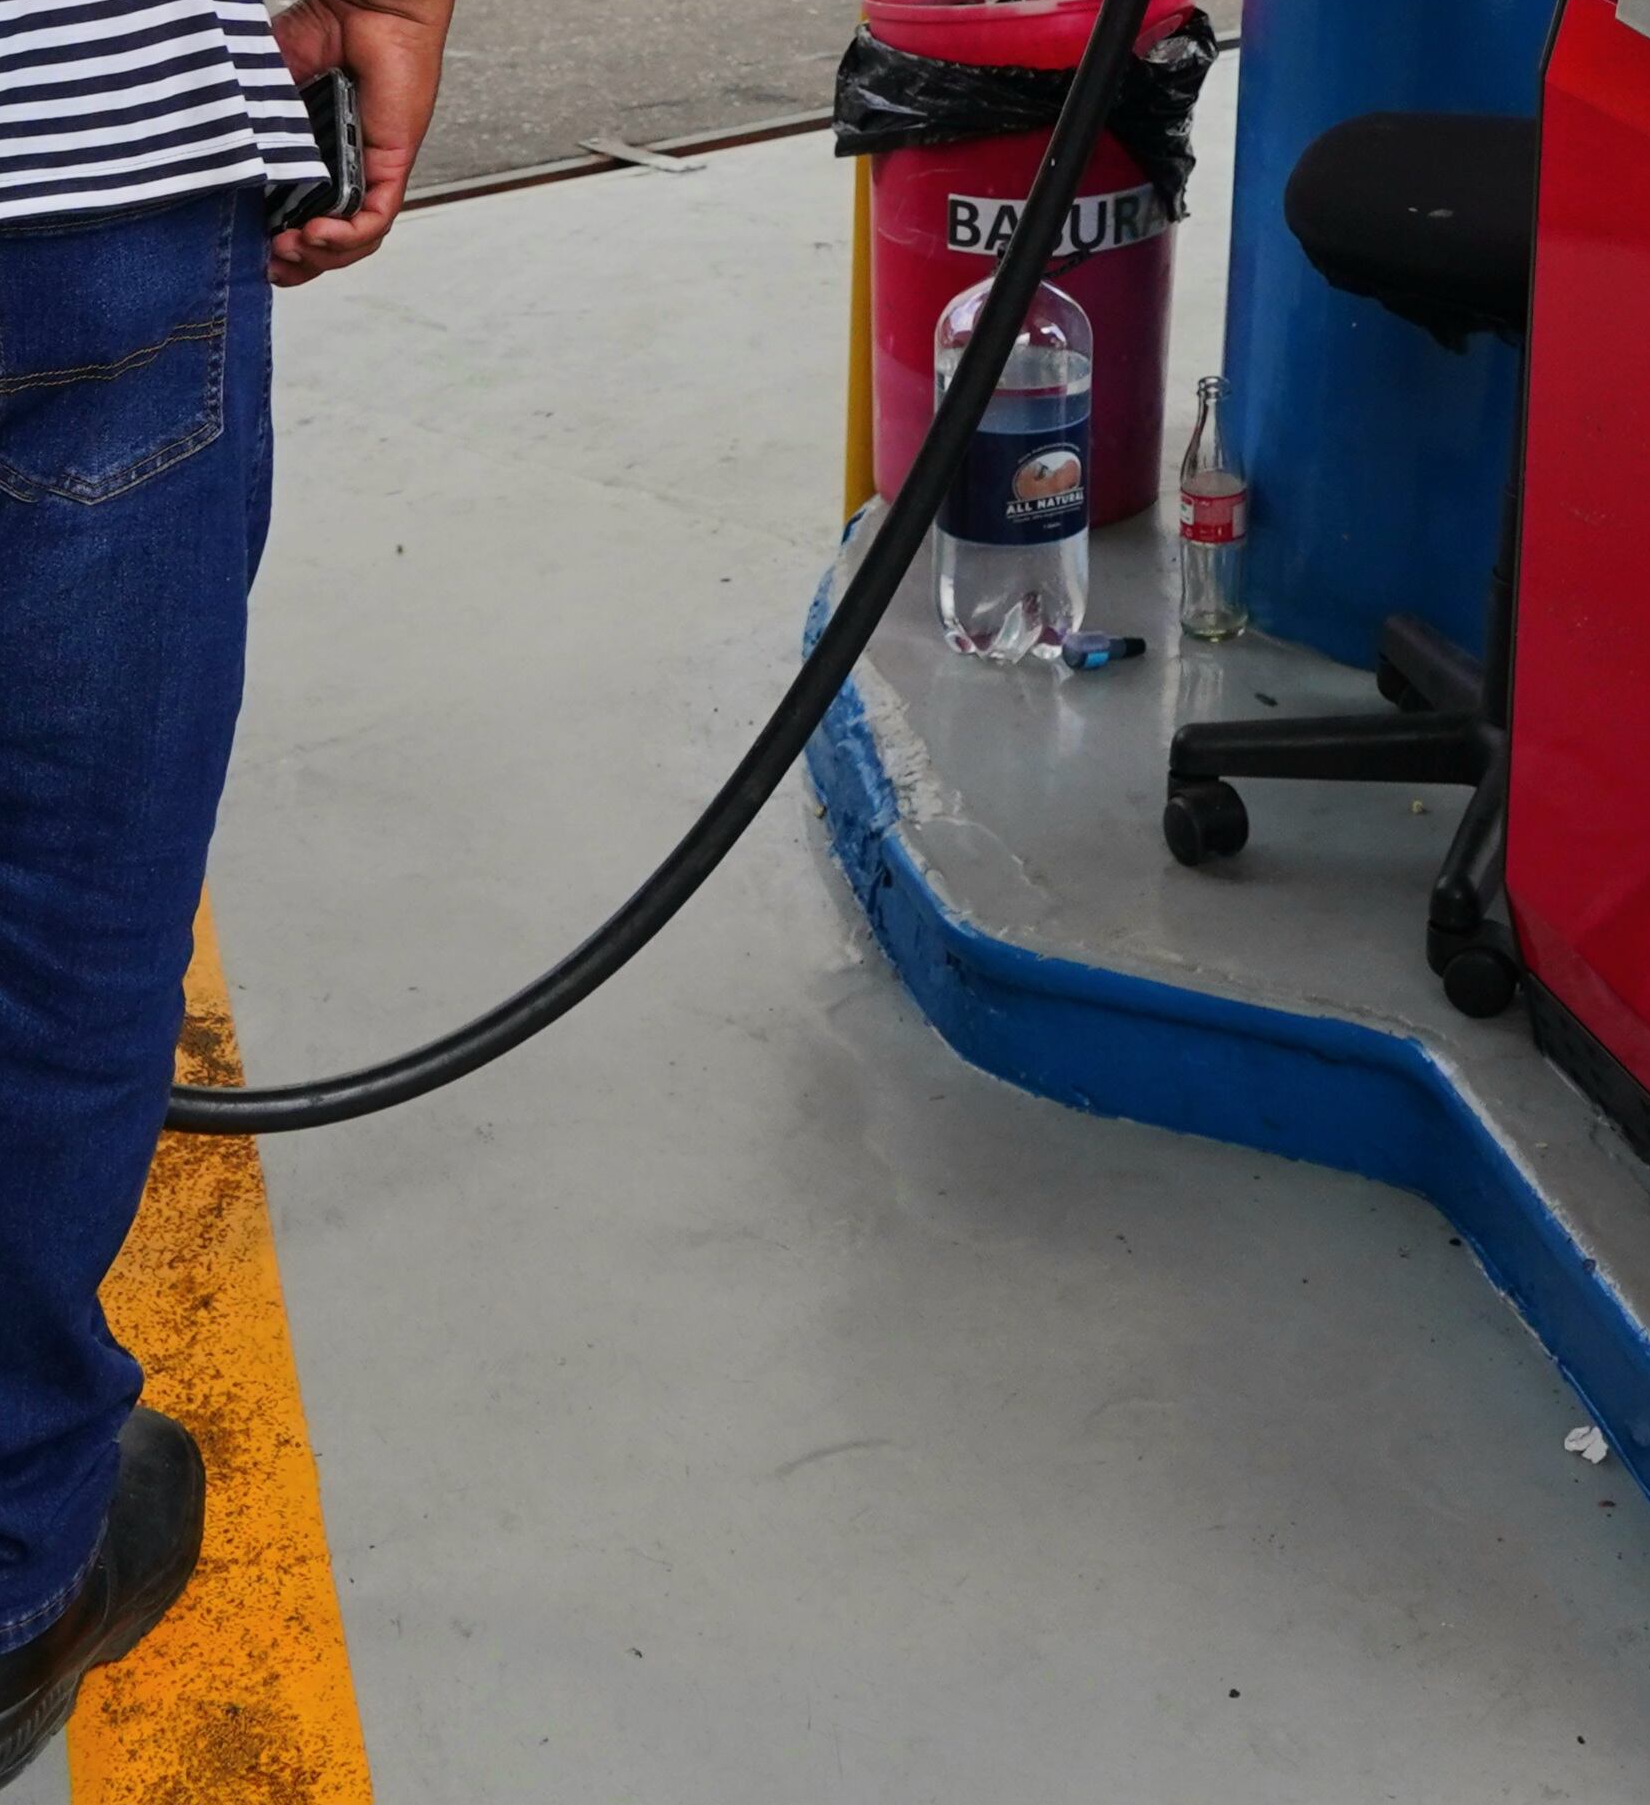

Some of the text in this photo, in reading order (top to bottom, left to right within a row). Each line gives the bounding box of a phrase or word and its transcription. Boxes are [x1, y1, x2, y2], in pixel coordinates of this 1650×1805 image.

[949, 194, 1166, 251] BAURA
[1006, 502, 1032, 515] ALL
[1037, 491, 1084, 509] NATURAL
